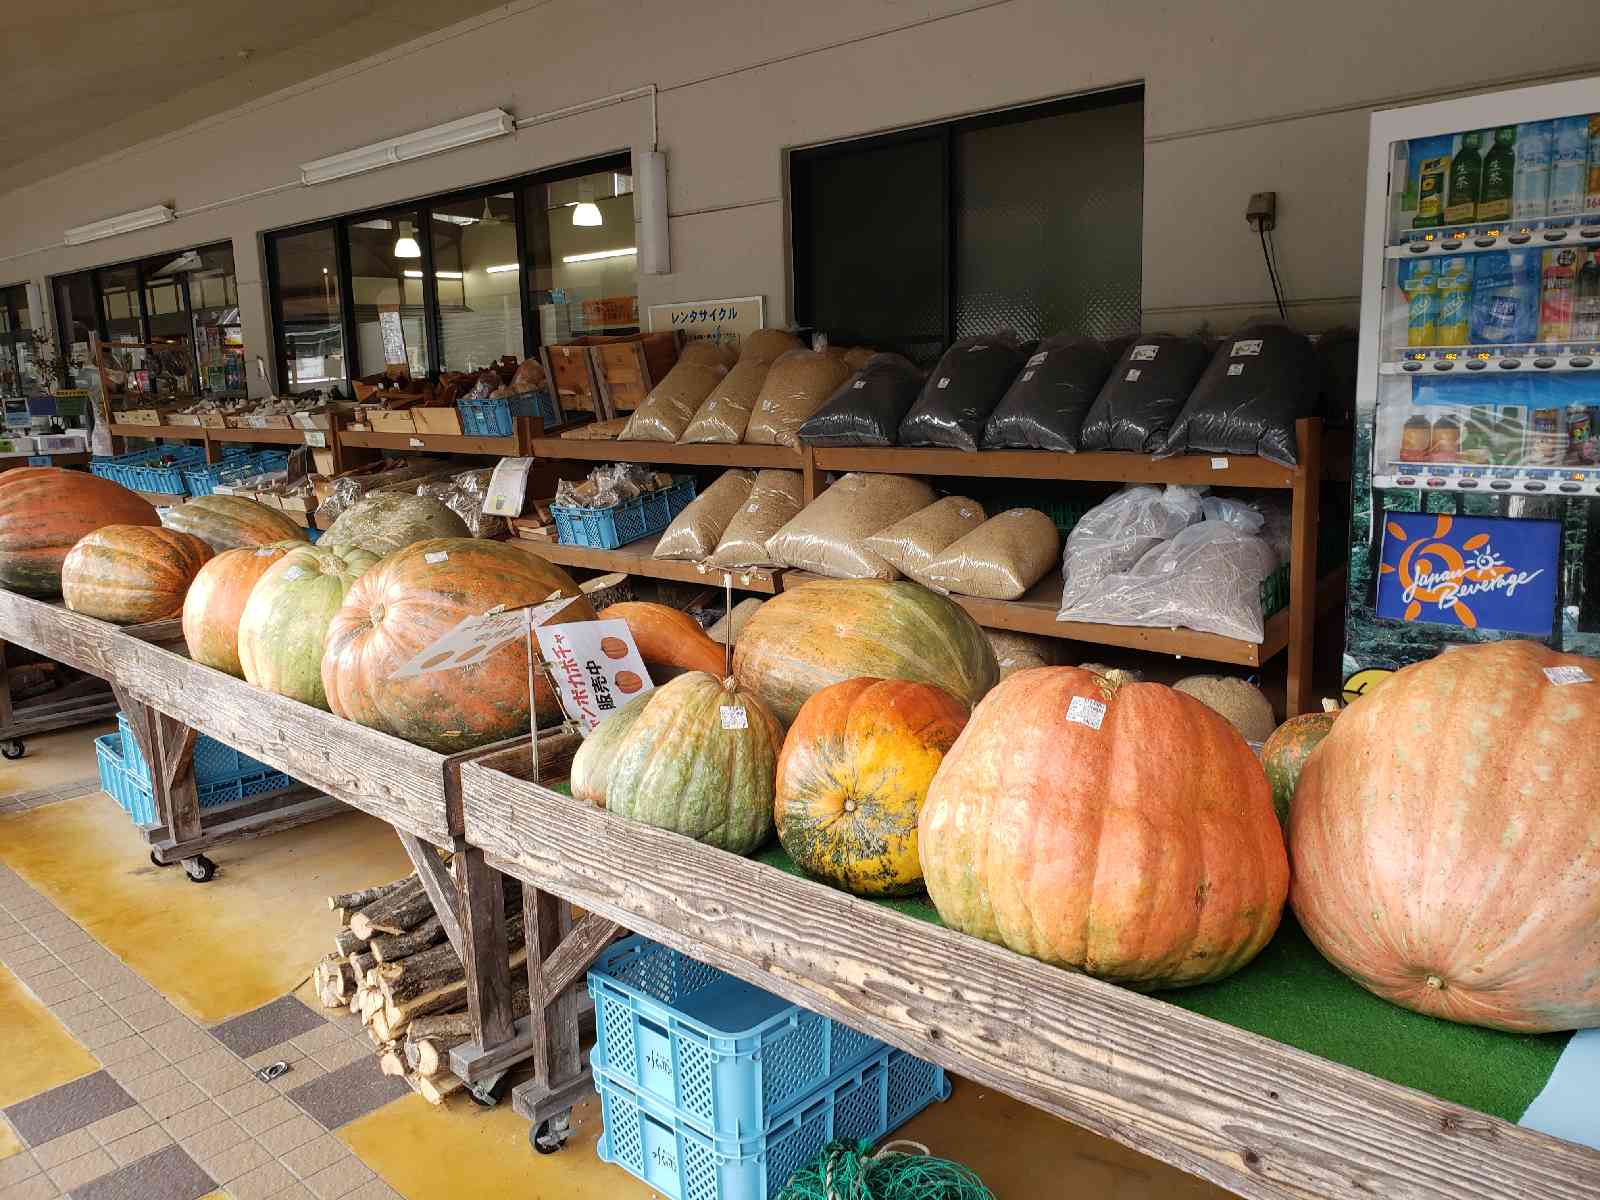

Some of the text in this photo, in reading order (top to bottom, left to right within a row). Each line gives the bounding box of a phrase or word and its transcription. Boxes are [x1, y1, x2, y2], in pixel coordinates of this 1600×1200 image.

[672, 306, 738, 324] レンタサイクル
[1402, 566, 1472, 603] Japan
[1432, 568, 1544, 609] Beverage
[551, 634, 601, 732] ャンボカボチャ
[585, 659, 617, 711] 販売中
